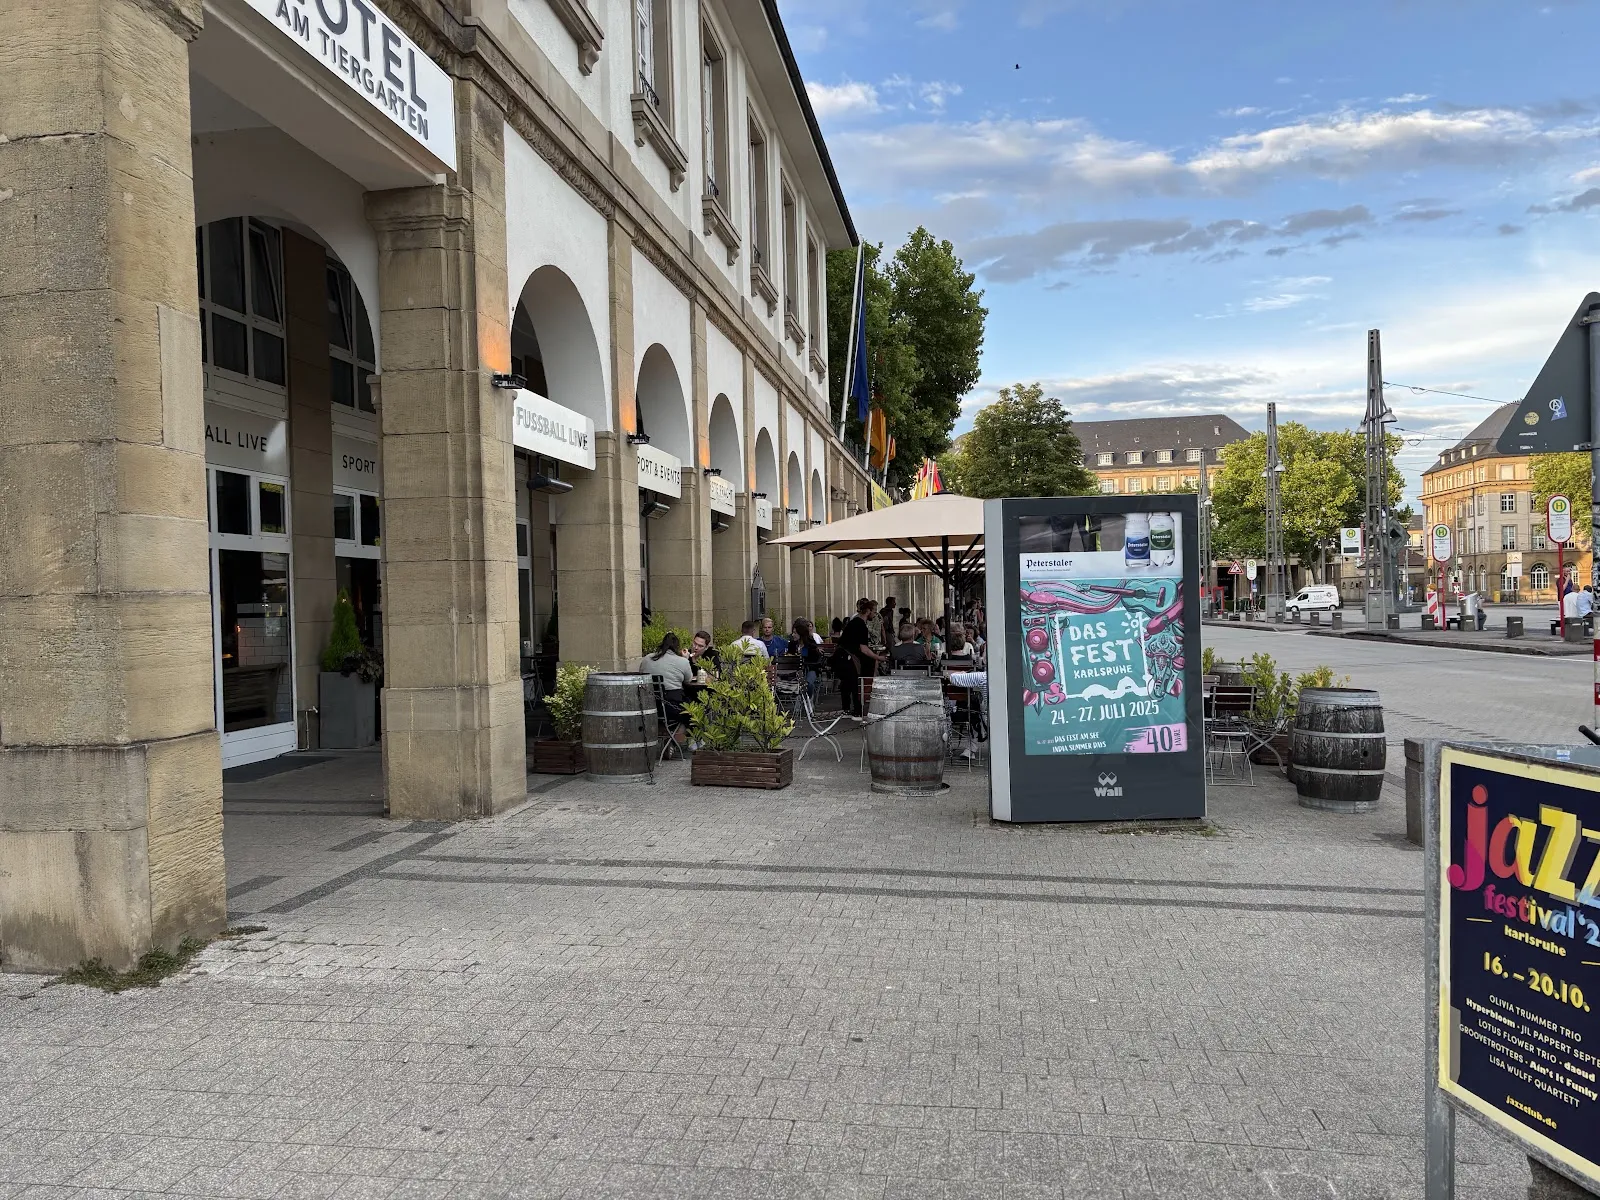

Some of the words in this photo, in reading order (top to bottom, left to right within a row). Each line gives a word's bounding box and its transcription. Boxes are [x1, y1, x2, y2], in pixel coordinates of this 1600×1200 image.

[299, 0, 428, 112] OTEL
[275, 0, 310, 42] AM
[317, 26, 429, 141] TIERGARTEN
[237, 431, 267, 452] LIVE
[516, 406, 567, 443] FUSSBALL
[568, 427, 588, 451] LIVE
[342, 454, 376, 474] SPORT
[660, 464, 681, 485] EVENTS
[1026, 559, 1073, 569] Peterstaler
[1069, 622, 1108, 641] DAS
[1070, 638, 1134, 666] FEST
[1073, 664, 1133, 679] KARLSRUHE
[1051, 709, 1069, 726] 24.
[1079, 706, 1097, 722] 27.
[1099, 703, 1126, 721] JULI
[1129, 700, 1160, 717] 2025
[1054, 735, 1066, 743] DAS
[1066, 733, 1079, 742] FEST
[1080, 732, 1089, 740] AM
[1069, 741, 1092, 751] SUMMER
[1147, 726, 1173, 753] 40
[1094, 786, 1123, 797] Wall
[1504, 925, 1567, 957] karlsruhe
[1465, 997, 1516, 1029] Hyperbloom
[1521, 1026, 1532, 1037] JIL
[1533, 1031, 1571, 1055] PAPPERT
[1489, 994, 1514, 1014] OLIVIA
[1515, 1006, 1558, 1033] TRUMMER
[1559, 1026, 1582, 1042] TRIO
[1459, 1023, 1524, 1064] GROOVETROTTERS
[1529, 1060, 1554, 1080] Ain't
[1555, 1073, 1565, 1085] It
[1566, 1078, 1599, 1102] Funky
[1478, 1018, 1502, 1037] LOTUS
[1502, 1031, 1535, 1054] FLOWER
[1536, 1047, 1557, 1065] TRIO
[1563, 1061, 1596, 1083] daoud
[1489, 1054, 1506, 1070] LISA
[1506, 1064, 1533, 1083] WULFF
[1534, 1077, 1581, 1108] QUARTETT
[1505, 1095, 1558, 1130] jazzclub.de
